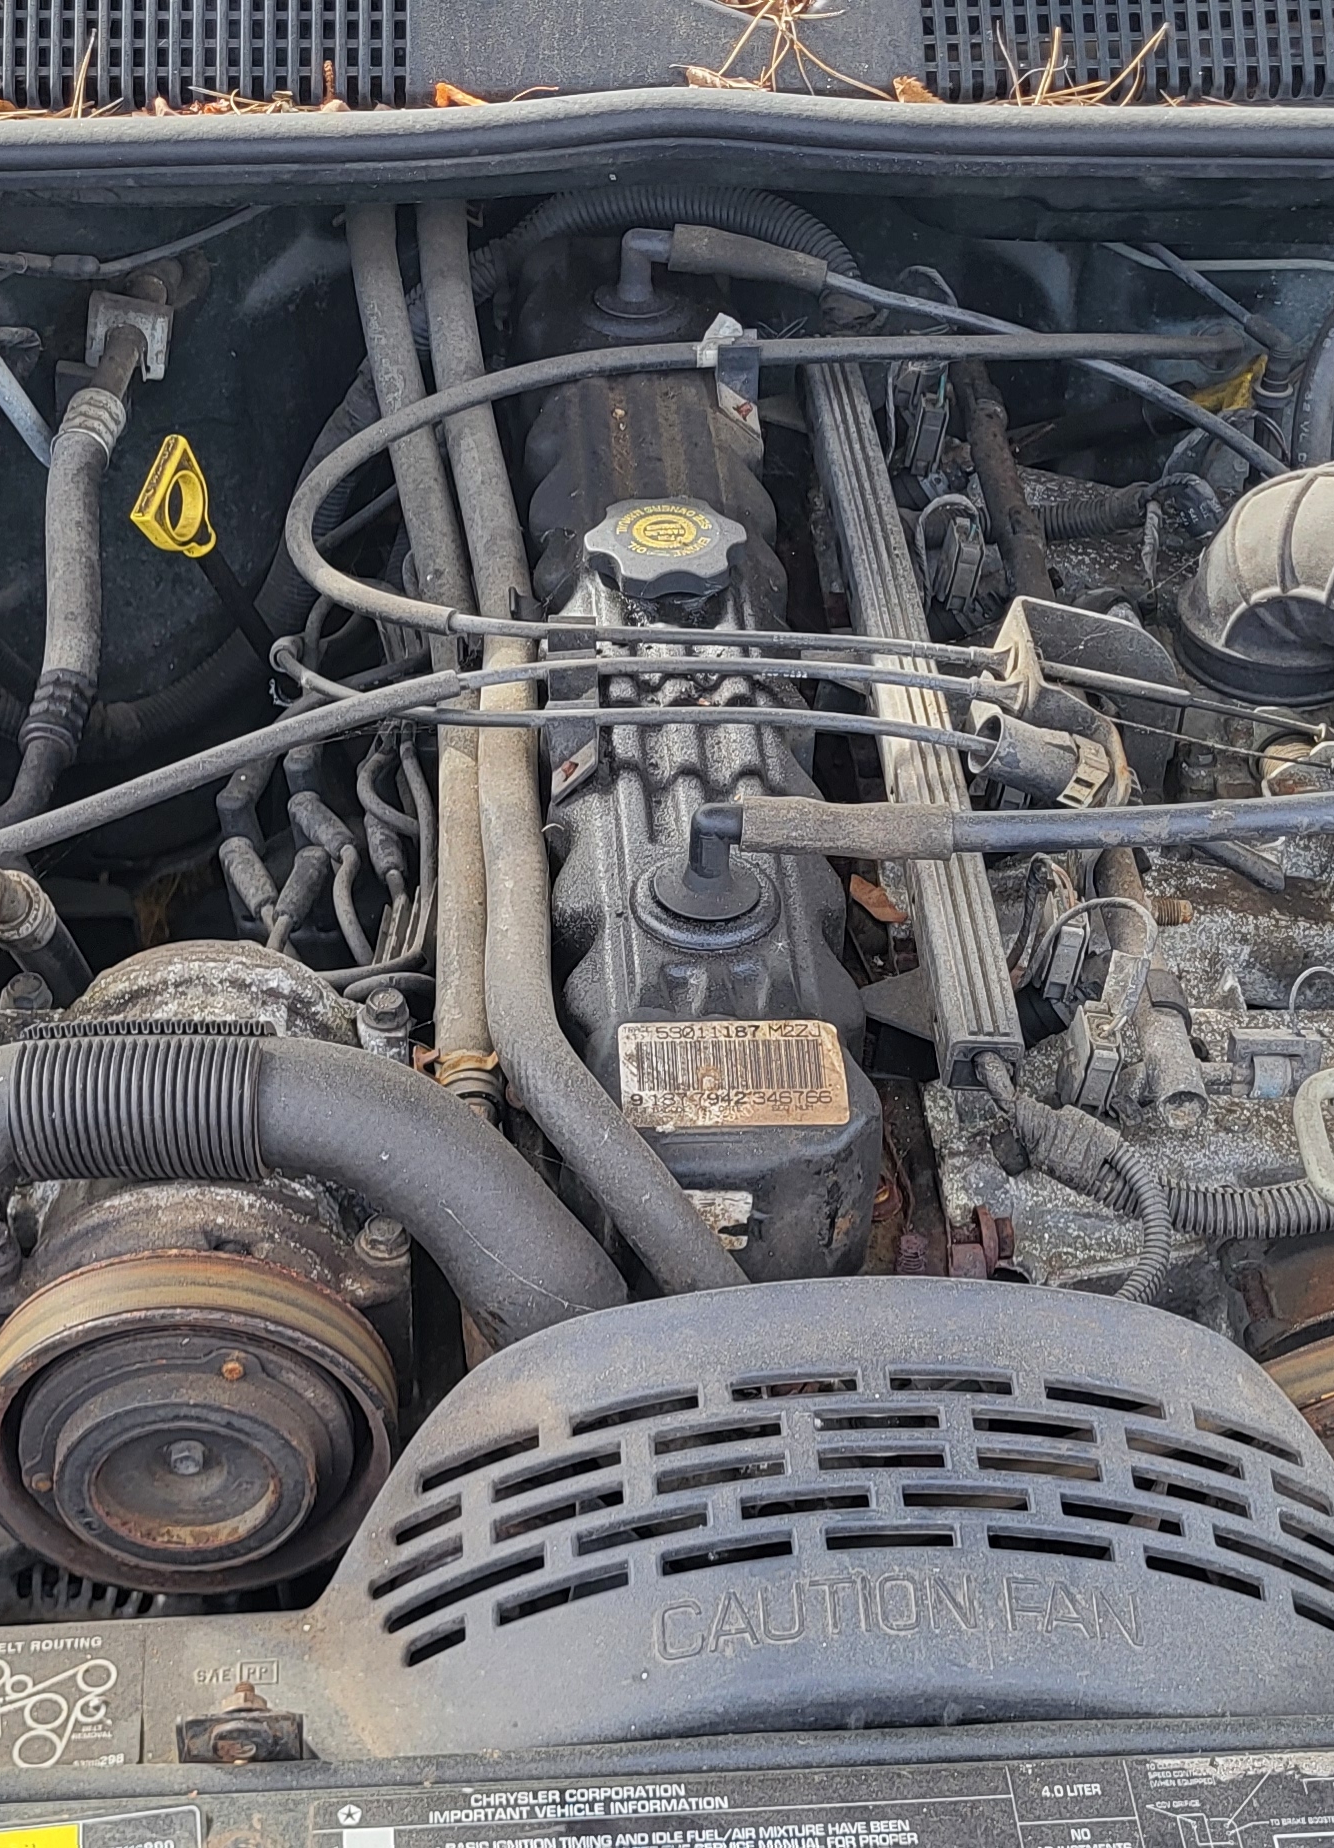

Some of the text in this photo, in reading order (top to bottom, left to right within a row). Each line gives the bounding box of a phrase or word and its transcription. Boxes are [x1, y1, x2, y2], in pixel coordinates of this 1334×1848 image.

[628, 540, 648, 555] OIL
[656, 1569, 1144, 1661] CAUTION FAN
[30, 1636, 102, 1652] ROUTING
[194, 1668, 231, 1683] SAE
[245, 1665, 269, 1681] PP
[470, 1784, 685, 1807] CHRYSLER CORPORATION
[1041, 1783, 1102, 1798] 4.0 LITER
[428, 1797, 729, 1824] IMPORTANT VEHICLE INFORMATION
[1281, 1816, 1306, 1825] BRAKE
[559, 1834, 612, 1848] TIMING
[615, 1832, 649, 1847] AND
[652, 1830, 684, 1845] IDLE
[687, 1826, 756, 1844] FUEL/AIR
[759, 1822, 825, 1840] MIXTURE
[828, 1820, 868, 1836] HAVE
[870, 1818, 910, 1834] BEEN
[826, 1835, 856, 1848] FOR
[859, 1832, 919, 1847] PROPER
[1070, 1827, 1091, 1841] NO
